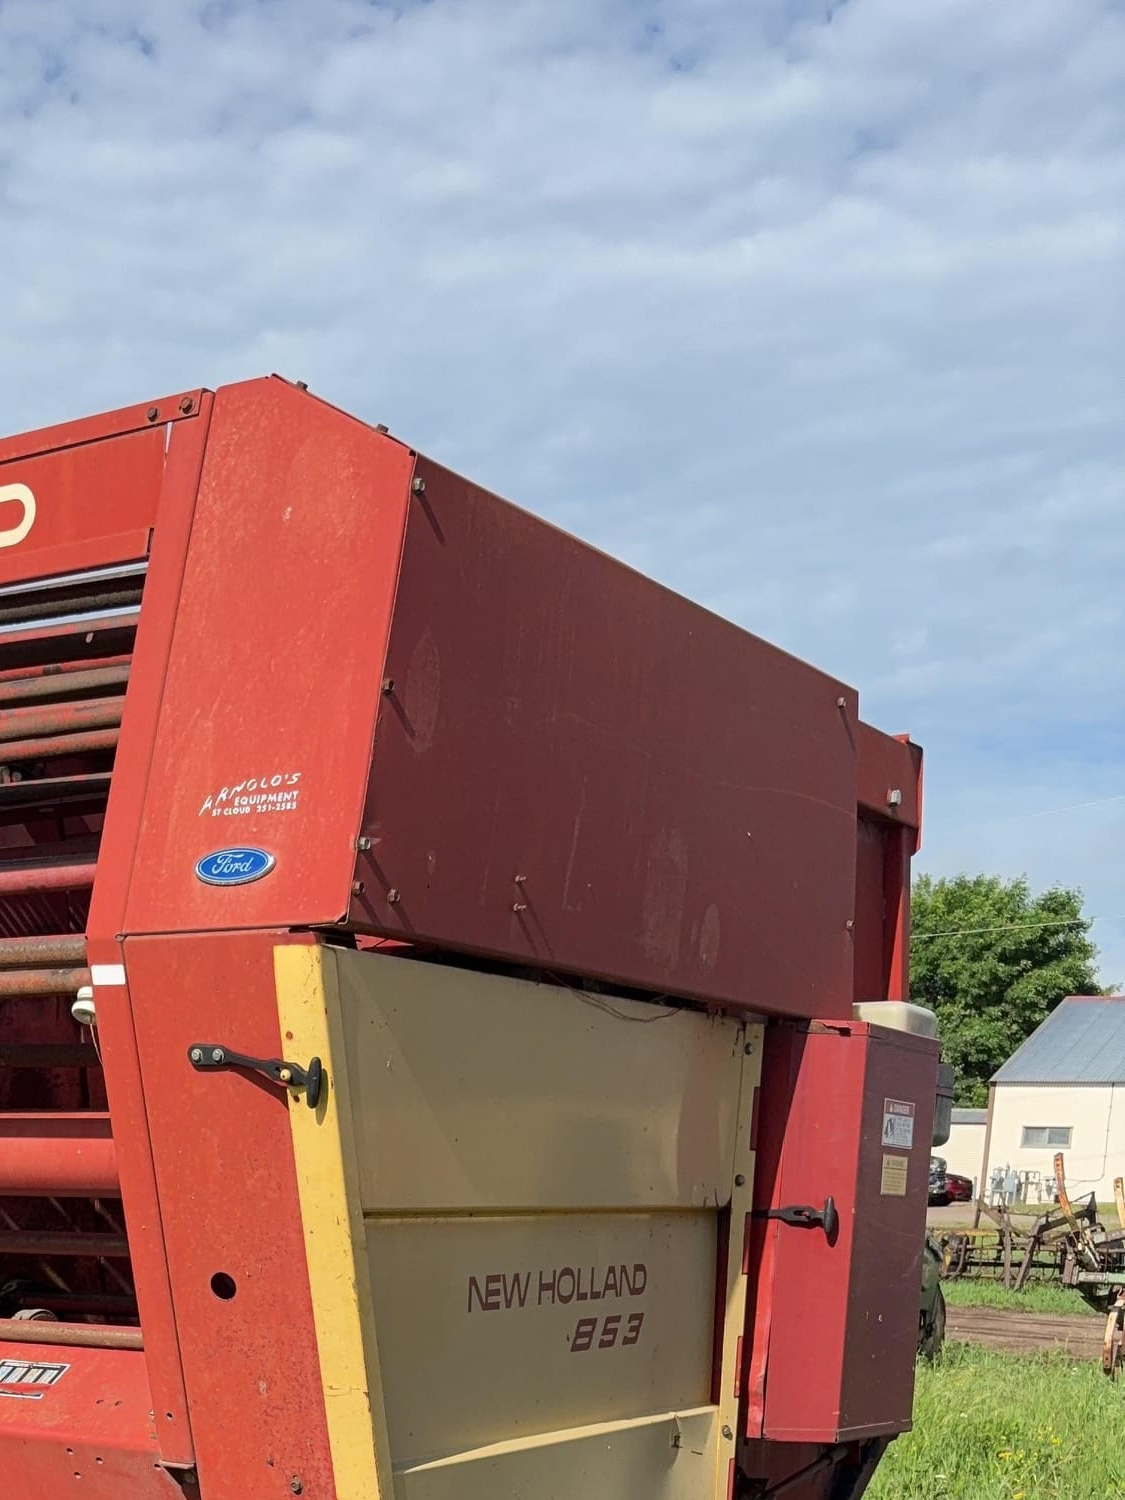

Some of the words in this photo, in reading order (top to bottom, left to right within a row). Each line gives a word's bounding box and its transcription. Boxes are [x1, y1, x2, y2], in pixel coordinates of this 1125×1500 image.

[234, 790, 299, 807] EQUIPMENT
[211, 808, 221, 817] ST
[223, 806, 251, 816] CLOUD
[211, 853, 254, 875] Ford
[467, 1271, 532, 1313] NEW
[537, 1263, 648, 1306] HOLLAND
[570, 1312, 645, 1353] 853
